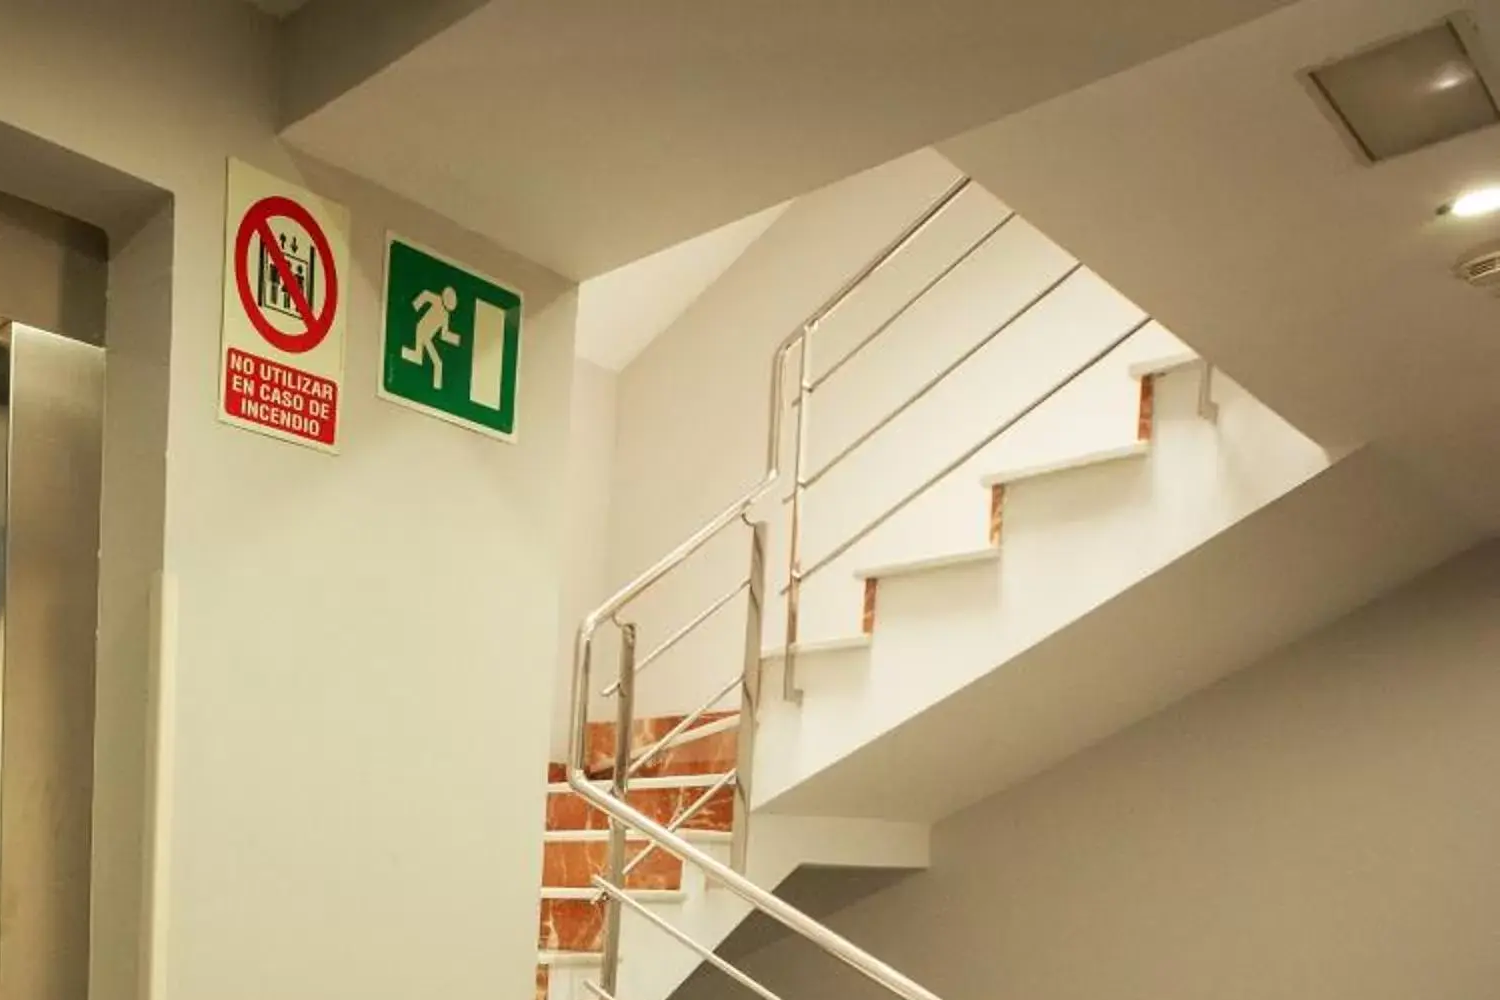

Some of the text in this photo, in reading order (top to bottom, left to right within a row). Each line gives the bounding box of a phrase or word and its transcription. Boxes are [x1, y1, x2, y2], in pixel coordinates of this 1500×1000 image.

[230, 352, 333, 400] NO UTILIZAR
[232, 375, 331, 420] EN CASO DE
[241, 398, 320, 437] INCENDIO
